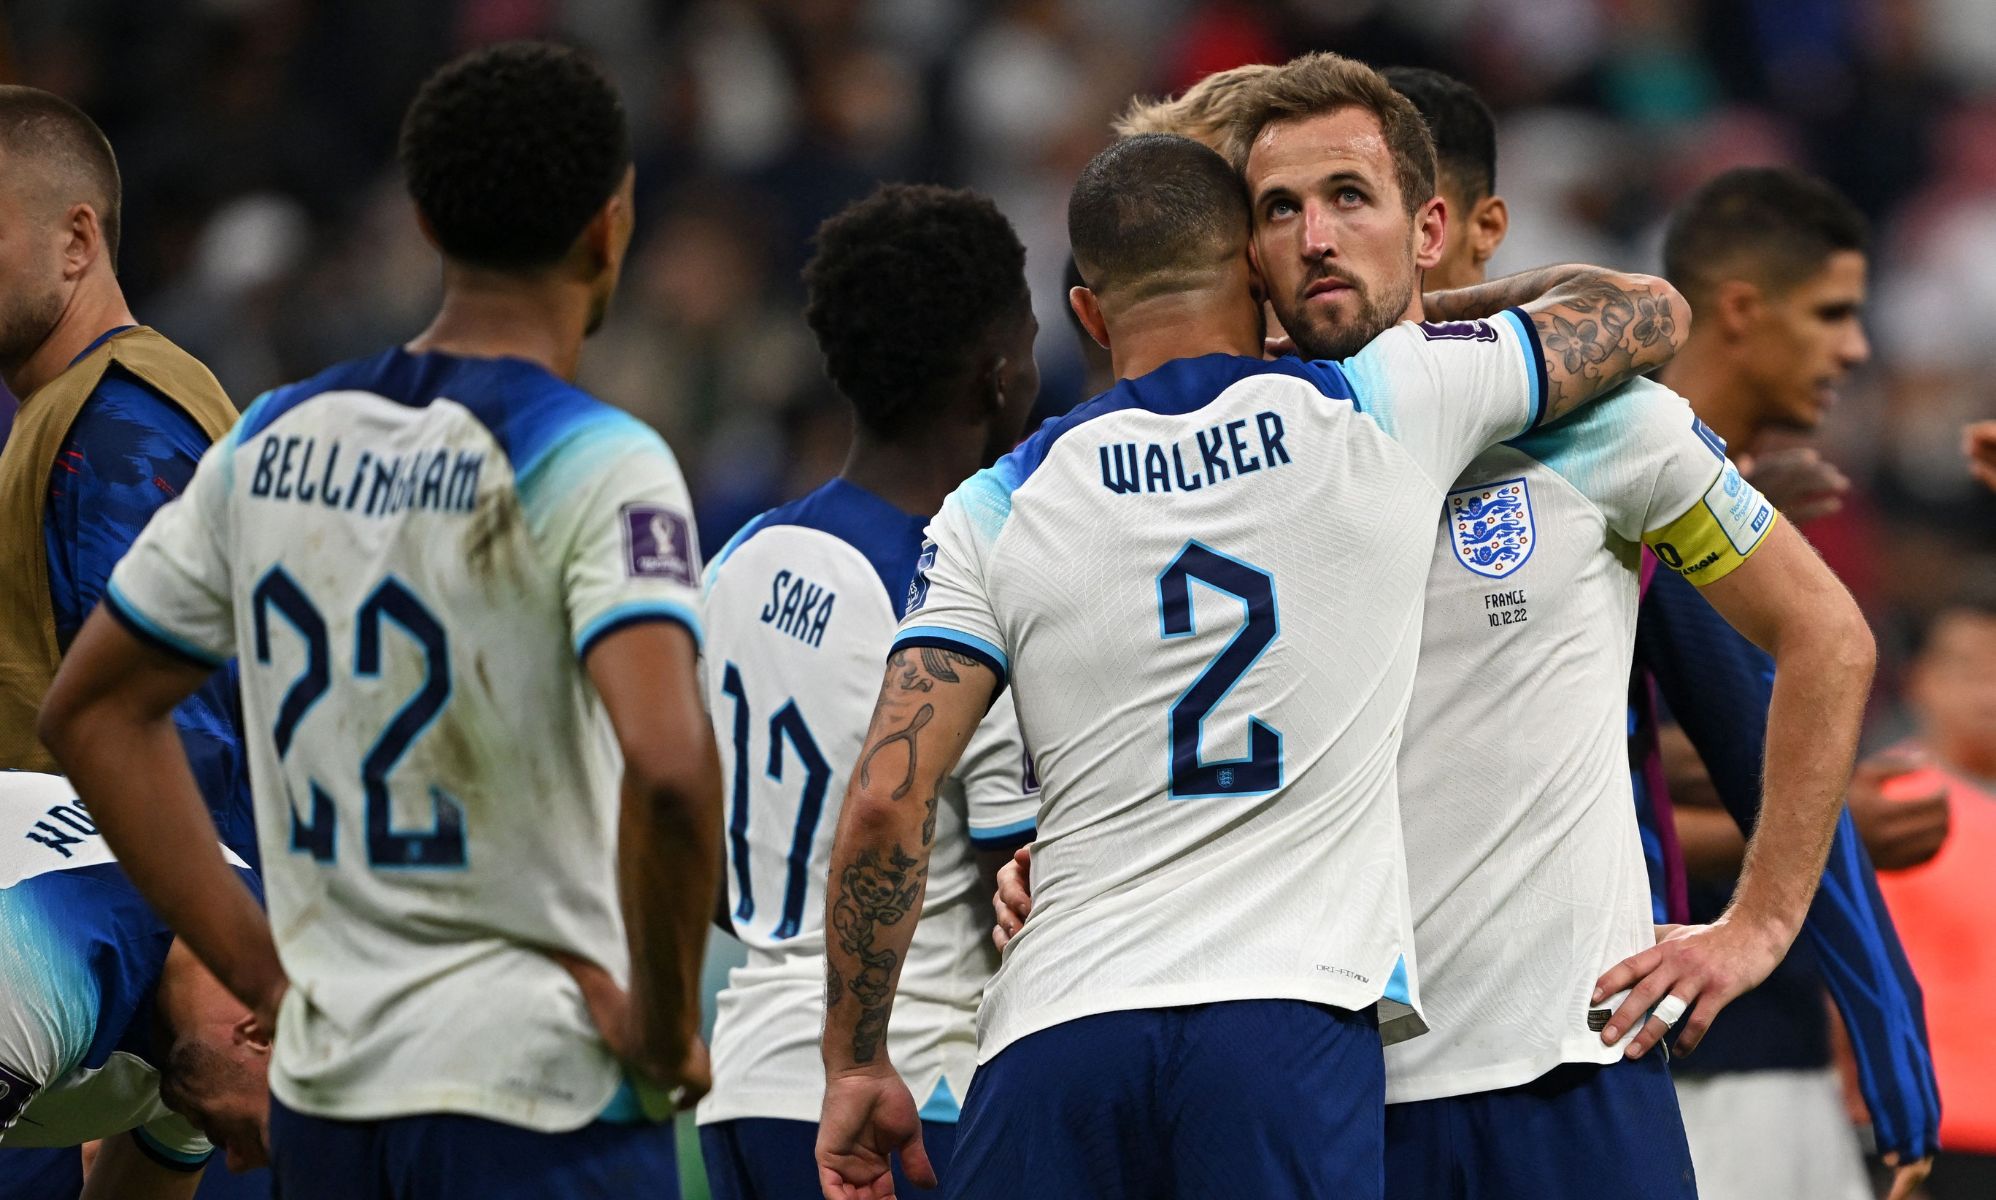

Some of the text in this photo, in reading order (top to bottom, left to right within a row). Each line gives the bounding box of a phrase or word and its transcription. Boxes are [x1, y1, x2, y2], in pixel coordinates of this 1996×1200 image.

[251, 434, 484, 517] BELLINHAM
[1098, 410, 1292, 495] WALKER
[1753, 507, 1768, 530] FIFA
[1484, 589, 1527, 610] FRANCE
[1681, 552, 1719, 575] ATION
[760, 568, 836, 648] SAKA
[1487, 607, 1528, 628] 10.12.22
[1154, 537, 1284, 800] 2
[253, 560, 470, 873] 22
[722, 658, 832, 942] 17
